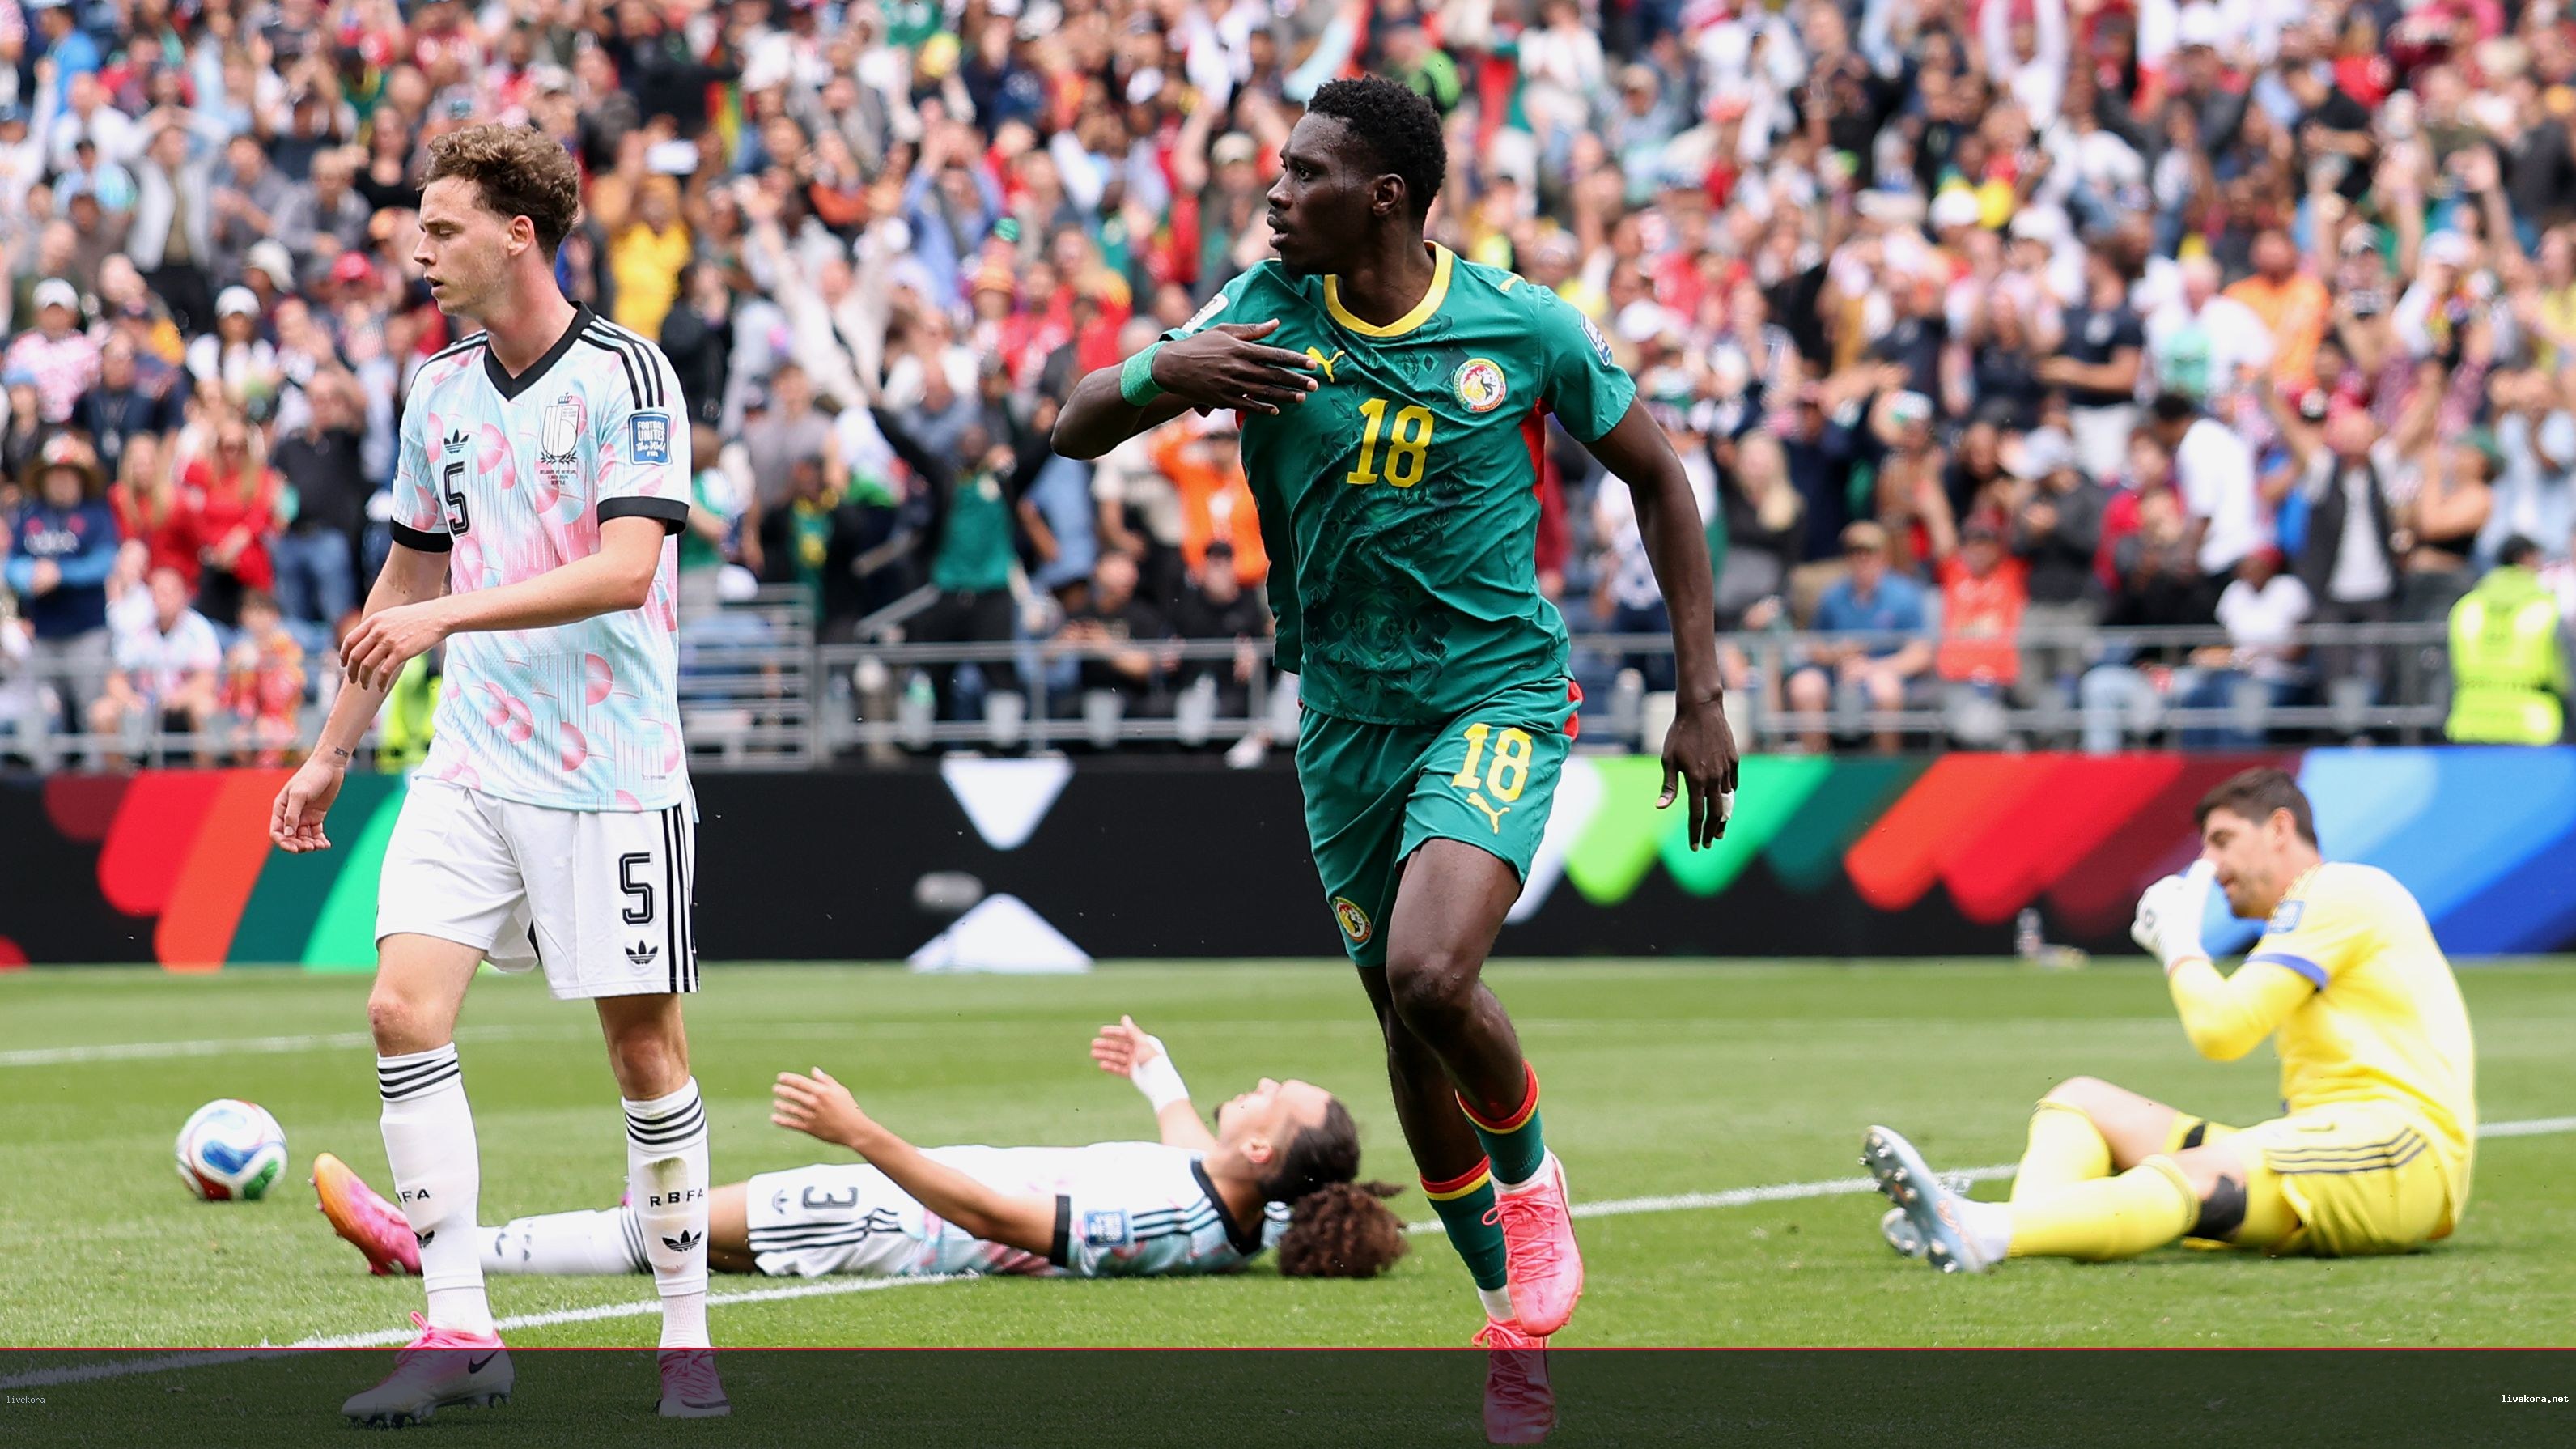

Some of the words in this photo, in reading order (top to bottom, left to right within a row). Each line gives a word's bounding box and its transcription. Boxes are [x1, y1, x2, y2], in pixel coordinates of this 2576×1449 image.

[637, 420, 664, 430] FOOTBALL
[638, 429, 666, 442] UNITES
[1346, 397, 1434, 488] 18
[443, 461, 470, 538] 5
[1451, 723, 1534, 803] 18
[619, 852, 655, 926] 5
[397, 1188, 430, 1203] FA
[650, 1188, 703, 1207] RBFA
[803, 1186, 858, 1209] 3
